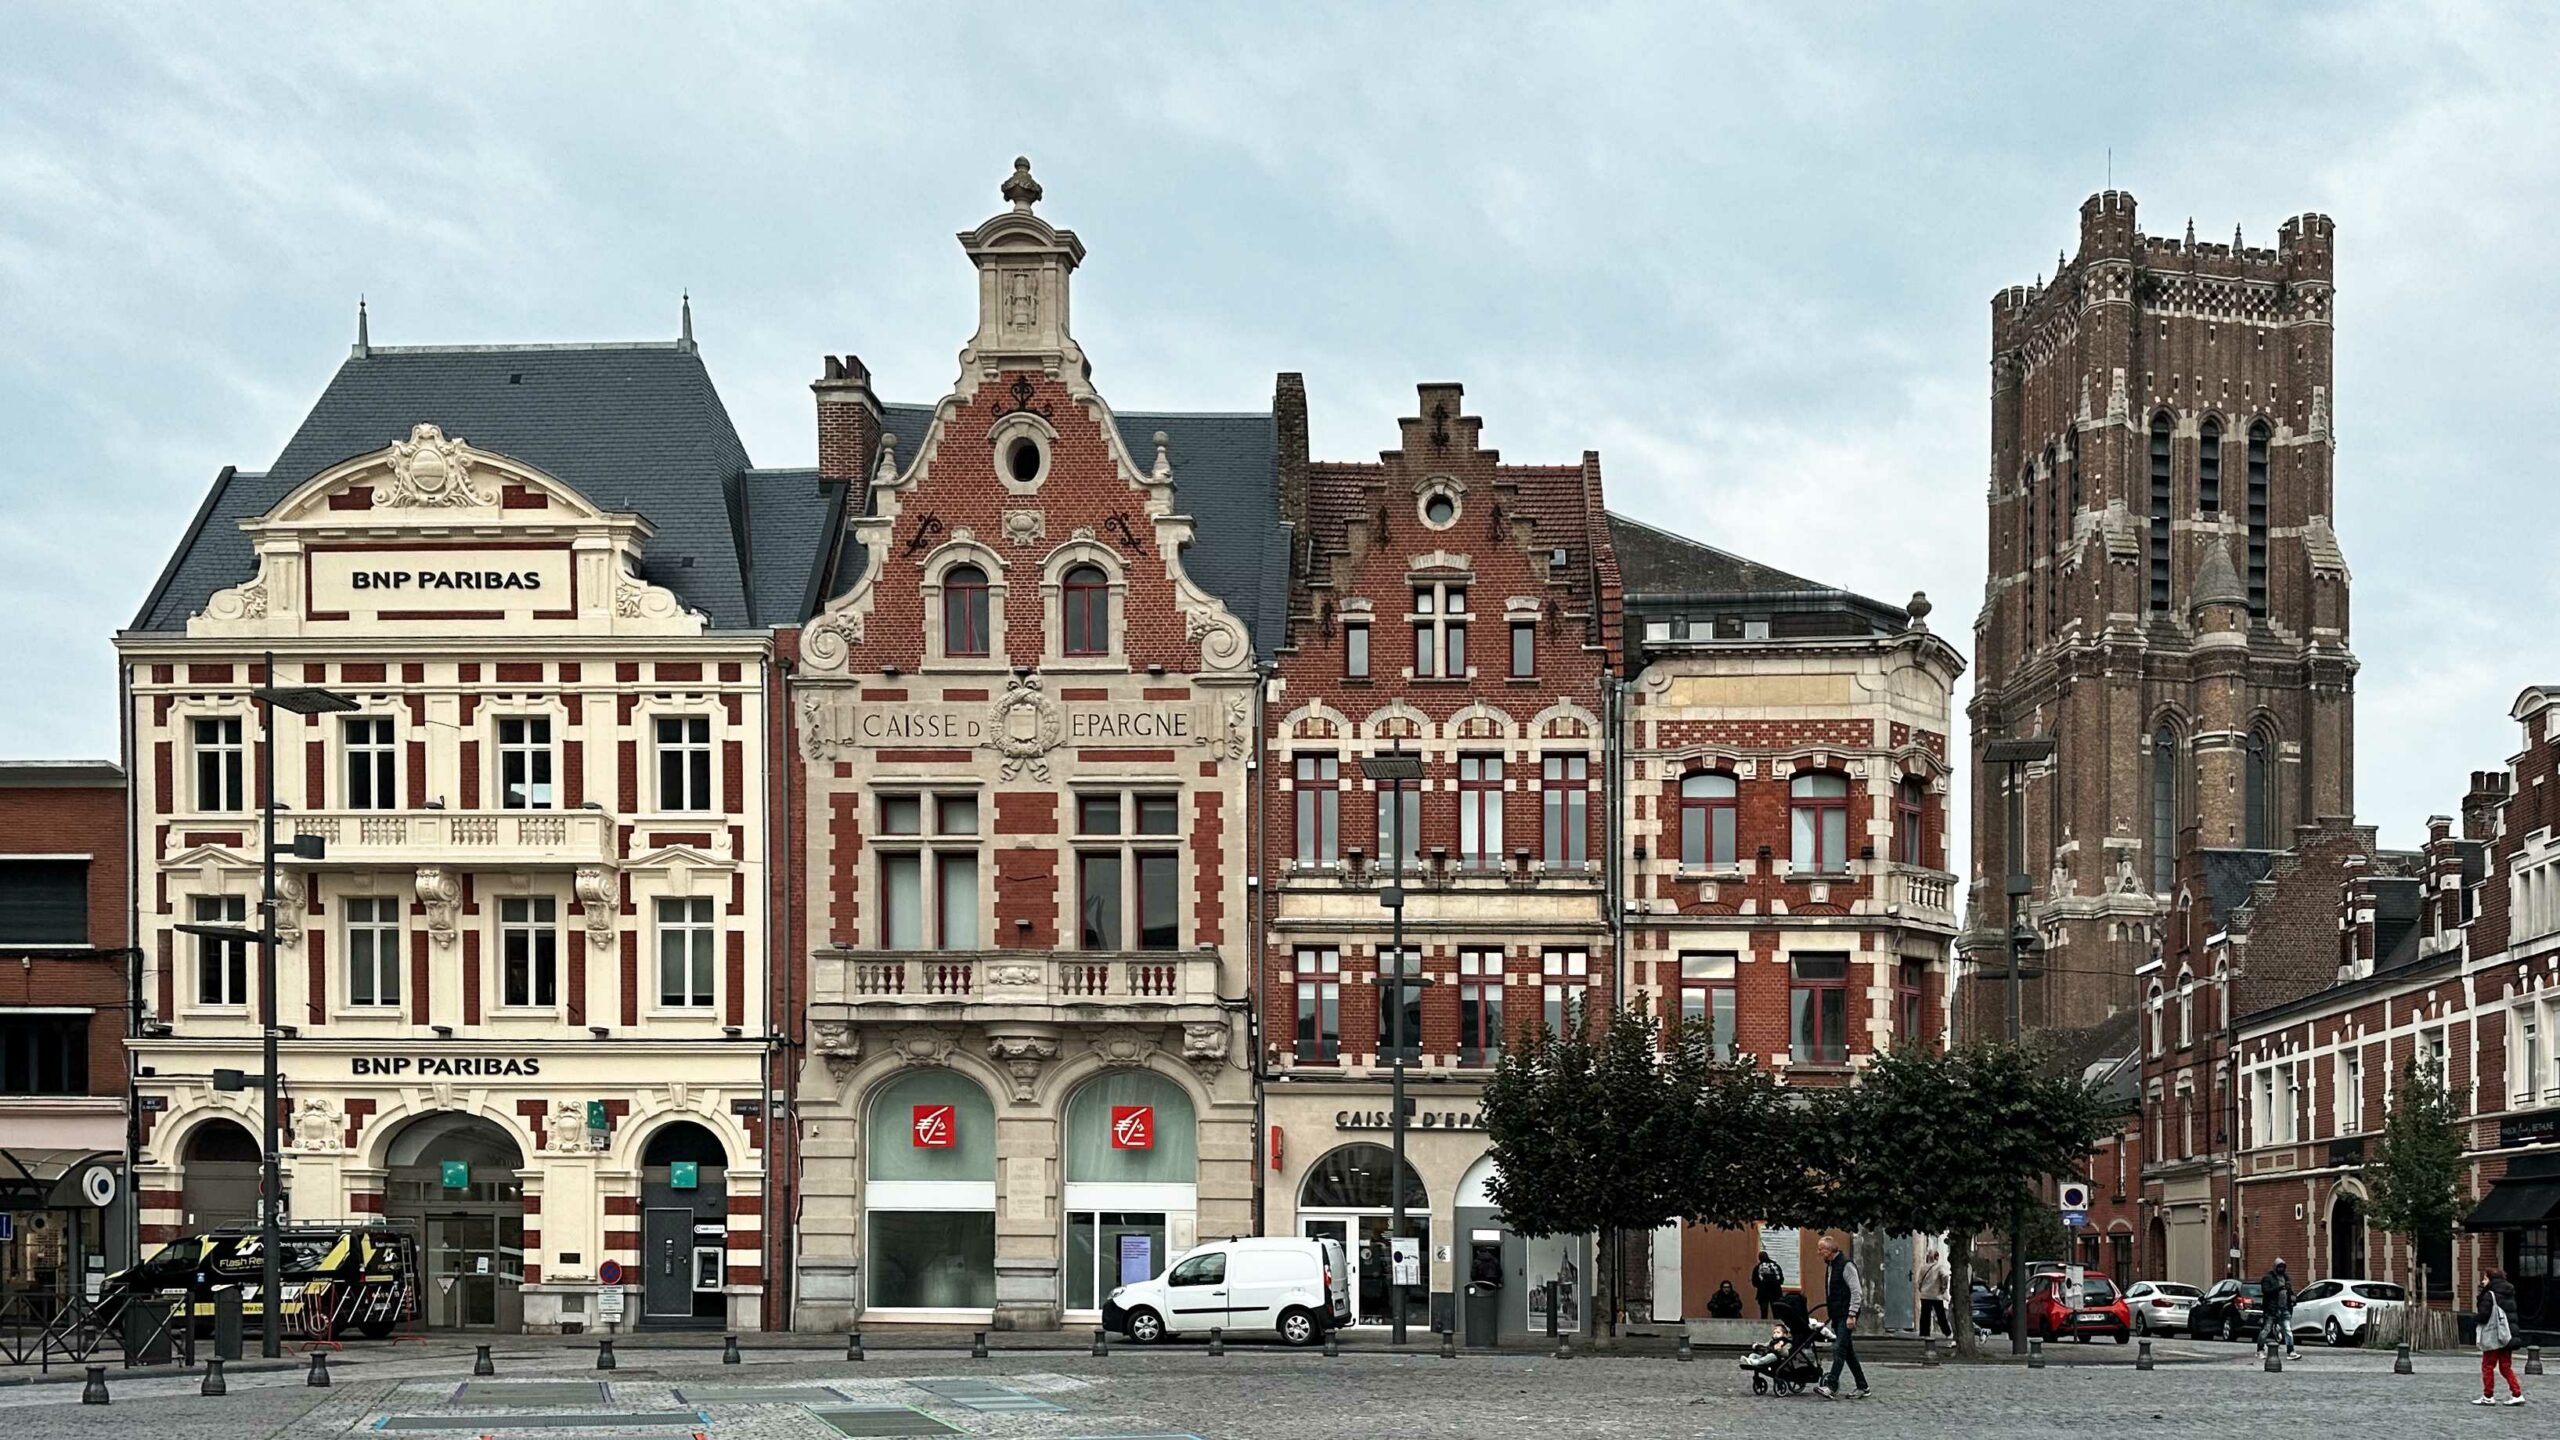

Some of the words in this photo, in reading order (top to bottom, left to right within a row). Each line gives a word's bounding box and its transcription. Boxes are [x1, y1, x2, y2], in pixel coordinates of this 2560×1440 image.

[352, 571, 411, 589] BNP
[418, 571, 541, 589] PARIBAS
[863, 714, 958, 738] CAISSE
[1072, 713, 1188, 737] EPARGNE
[351, 1058, 411, 1075] BNP
[418, 1058, 540, 1075] PARIBAS
[1422, 1111, 1487, 1128] D'EPA
[219, 1258, 247, 1267] Flash
